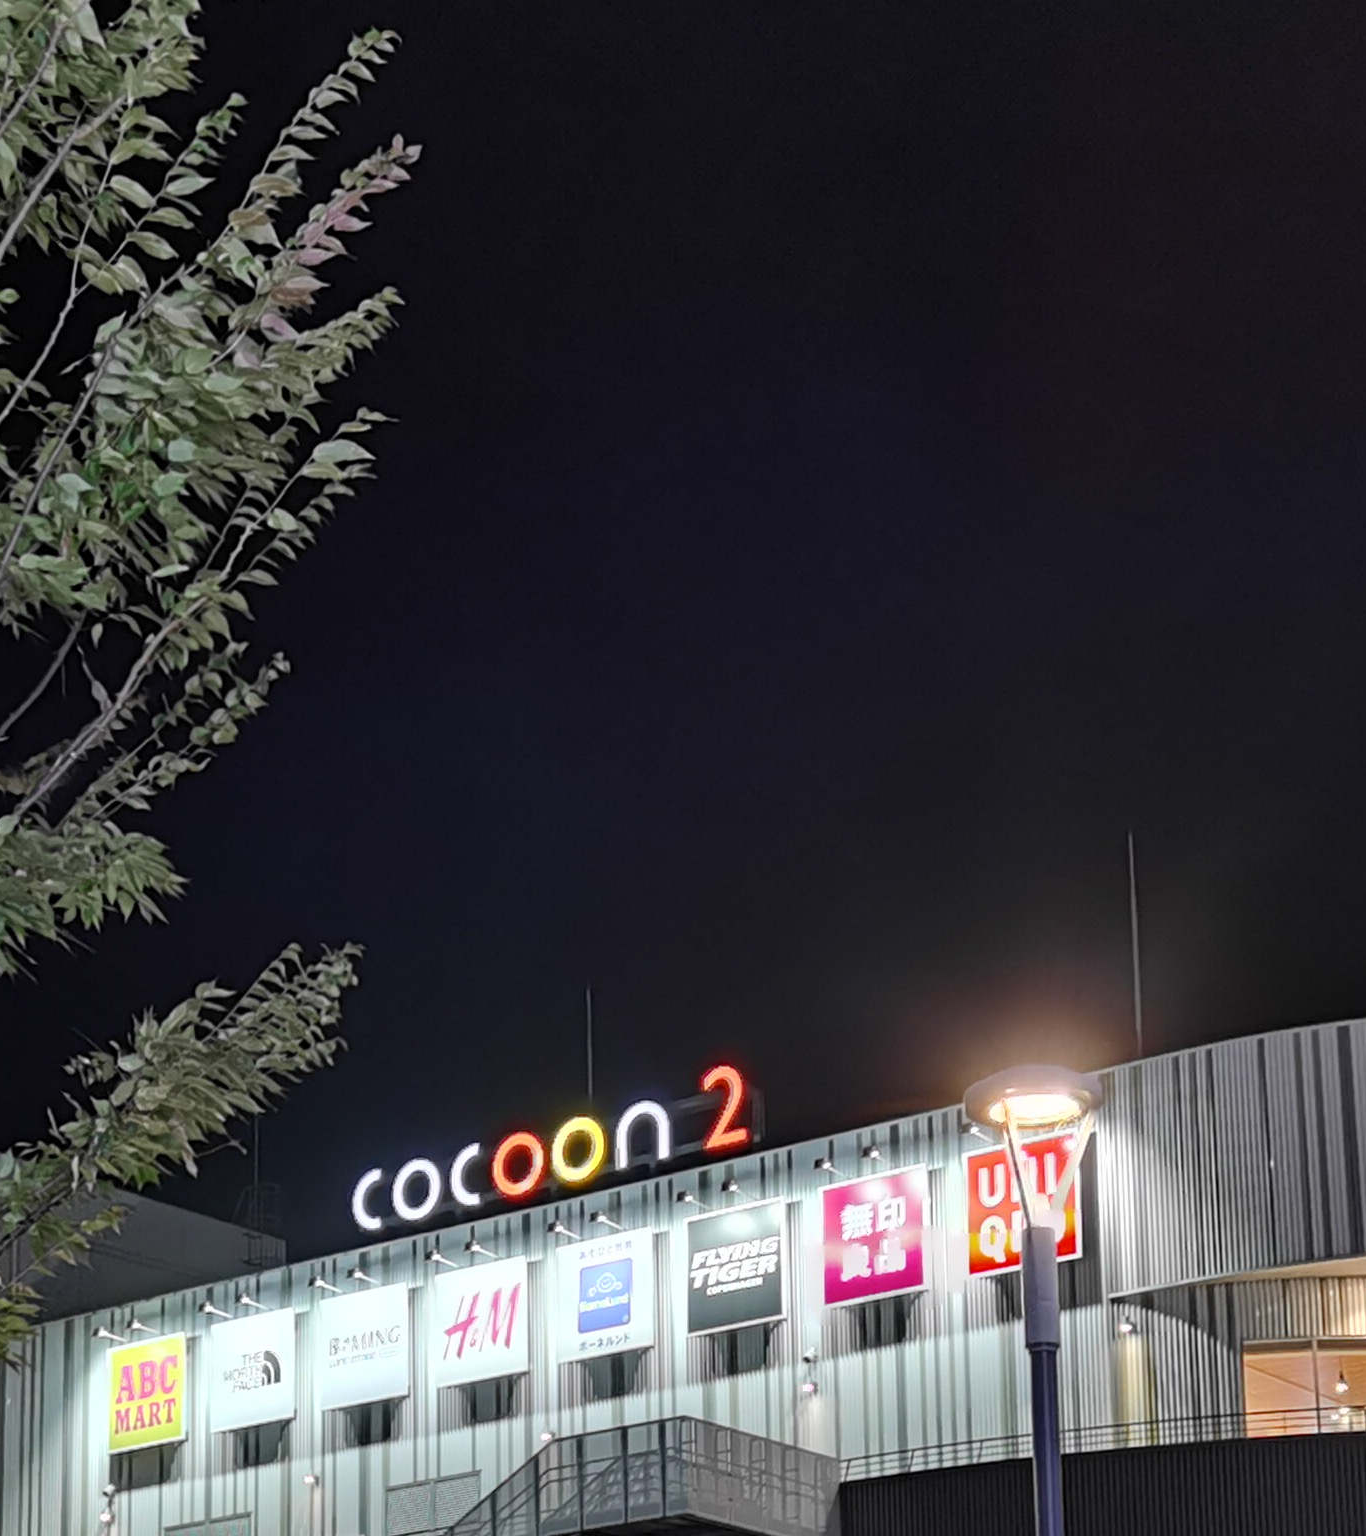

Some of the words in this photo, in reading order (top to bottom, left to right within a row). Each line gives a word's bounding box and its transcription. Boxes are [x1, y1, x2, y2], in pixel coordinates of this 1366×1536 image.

[351, 1099, 671, 1232] cocoon
[702, 1064, 748, 1151] 2
[840, 1195, 906, 1242] 無印
[690, 1253, 779, 1289] TIGER
[691, 1235, 781, 1270] FLYING
[443, 1282, 522, 1361] H&M
[241, 1350, 263, 1366] THE
[115, 1355, 178, 1405] ABC
[114, 1399, 177, 1435] MART
